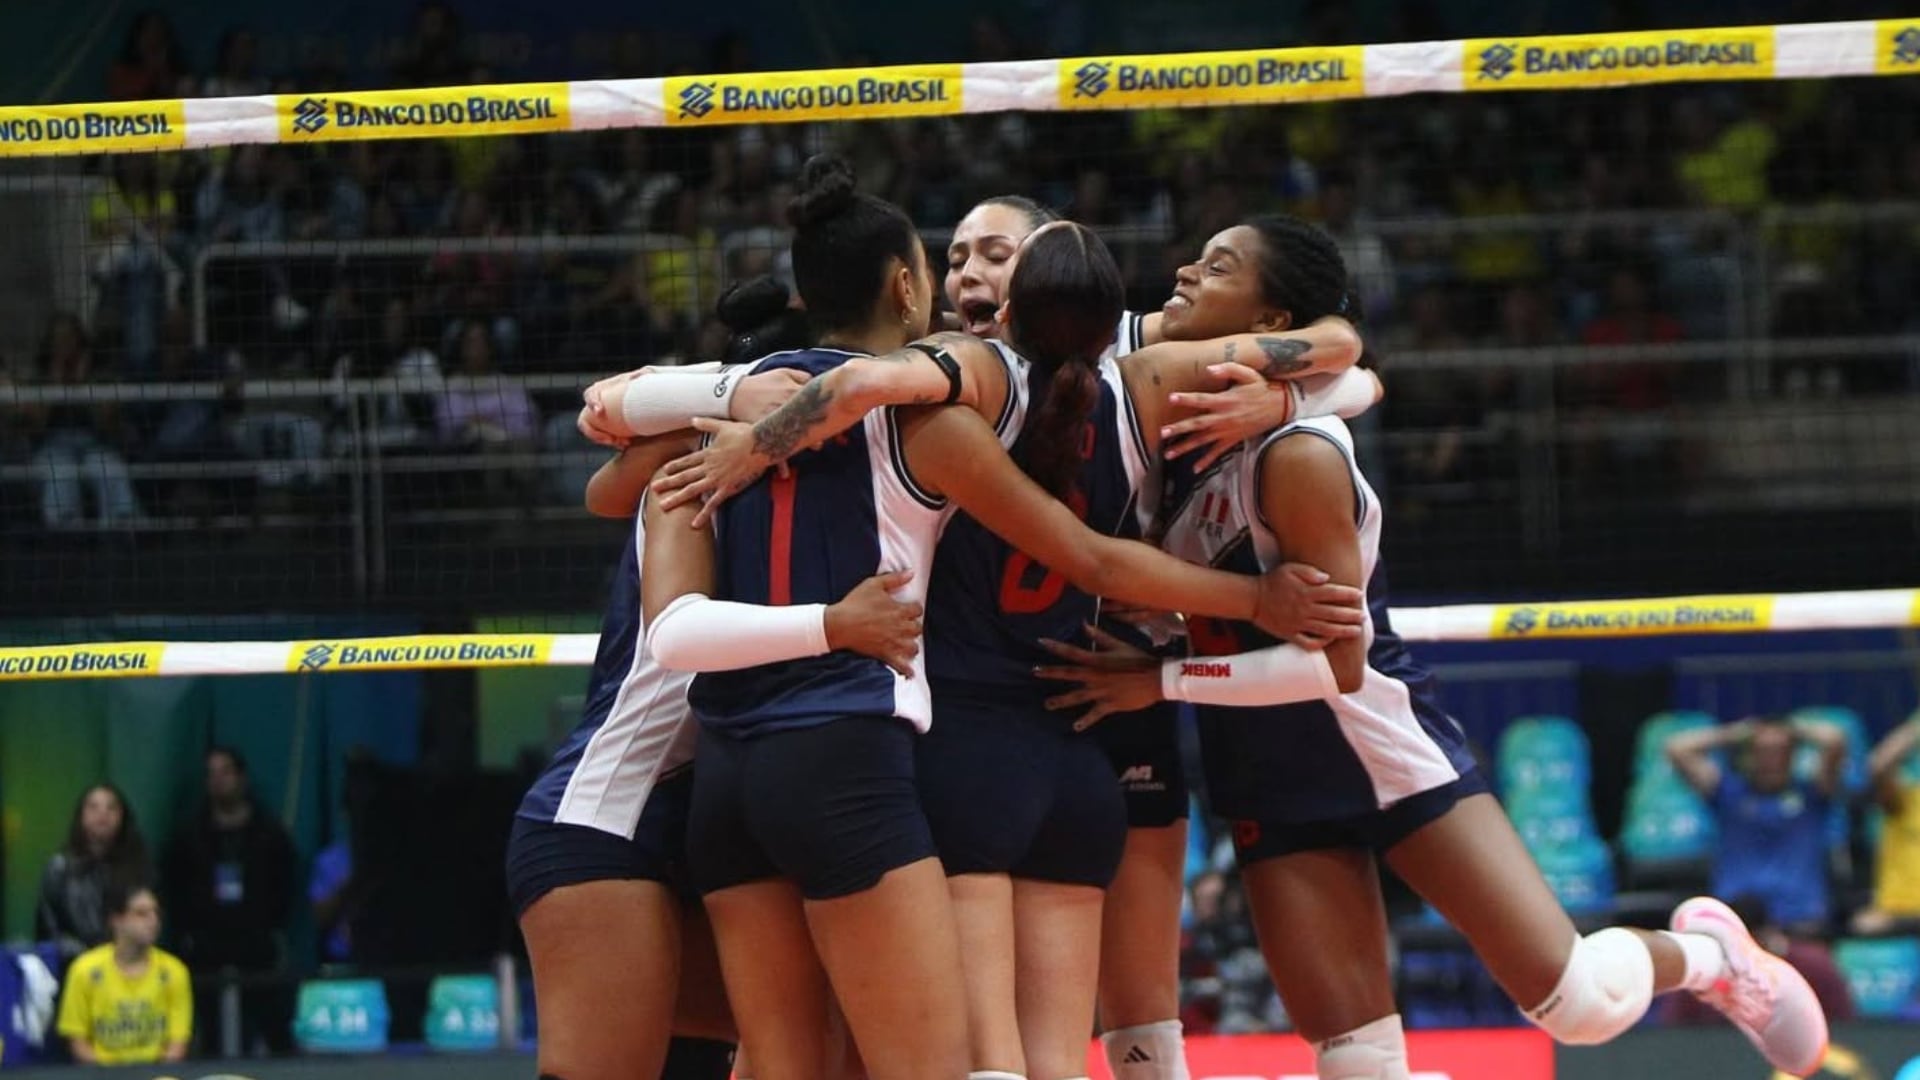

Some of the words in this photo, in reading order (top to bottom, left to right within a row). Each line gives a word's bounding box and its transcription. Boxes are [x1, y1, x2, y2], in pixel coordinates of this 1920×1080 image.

[1525, 46, 1620, 74] BANCO
[1624, 44, 1660, 68] DO
[1664, 40, 1757, 66] BRASIL
[1118, 65, 1211, 92] BANCO
[1217, 63, 1252, 88] DO
[1256, 57, 1350, 85] BRASIL
[722, 85, 814, 112] BANCO
[818, 84, 853, 107] DO
[857, 77, 949, 105] BRASIL
[46, 117, 81, 140] DO
[84, 112, 173, 138] BRASIL
[335, 101, 425, 127] BANCO
[429, 101, 463, 124] DO
[466, 96, 557, 123] BRASIL
[37, 655, 68, 672] DO
[70, 652, 148, 670] BRASIL
[338, 646, 421, 665] BANCO
[422, 645, 456, 661] DO
[458, 642, 536, 660] BRASIL
